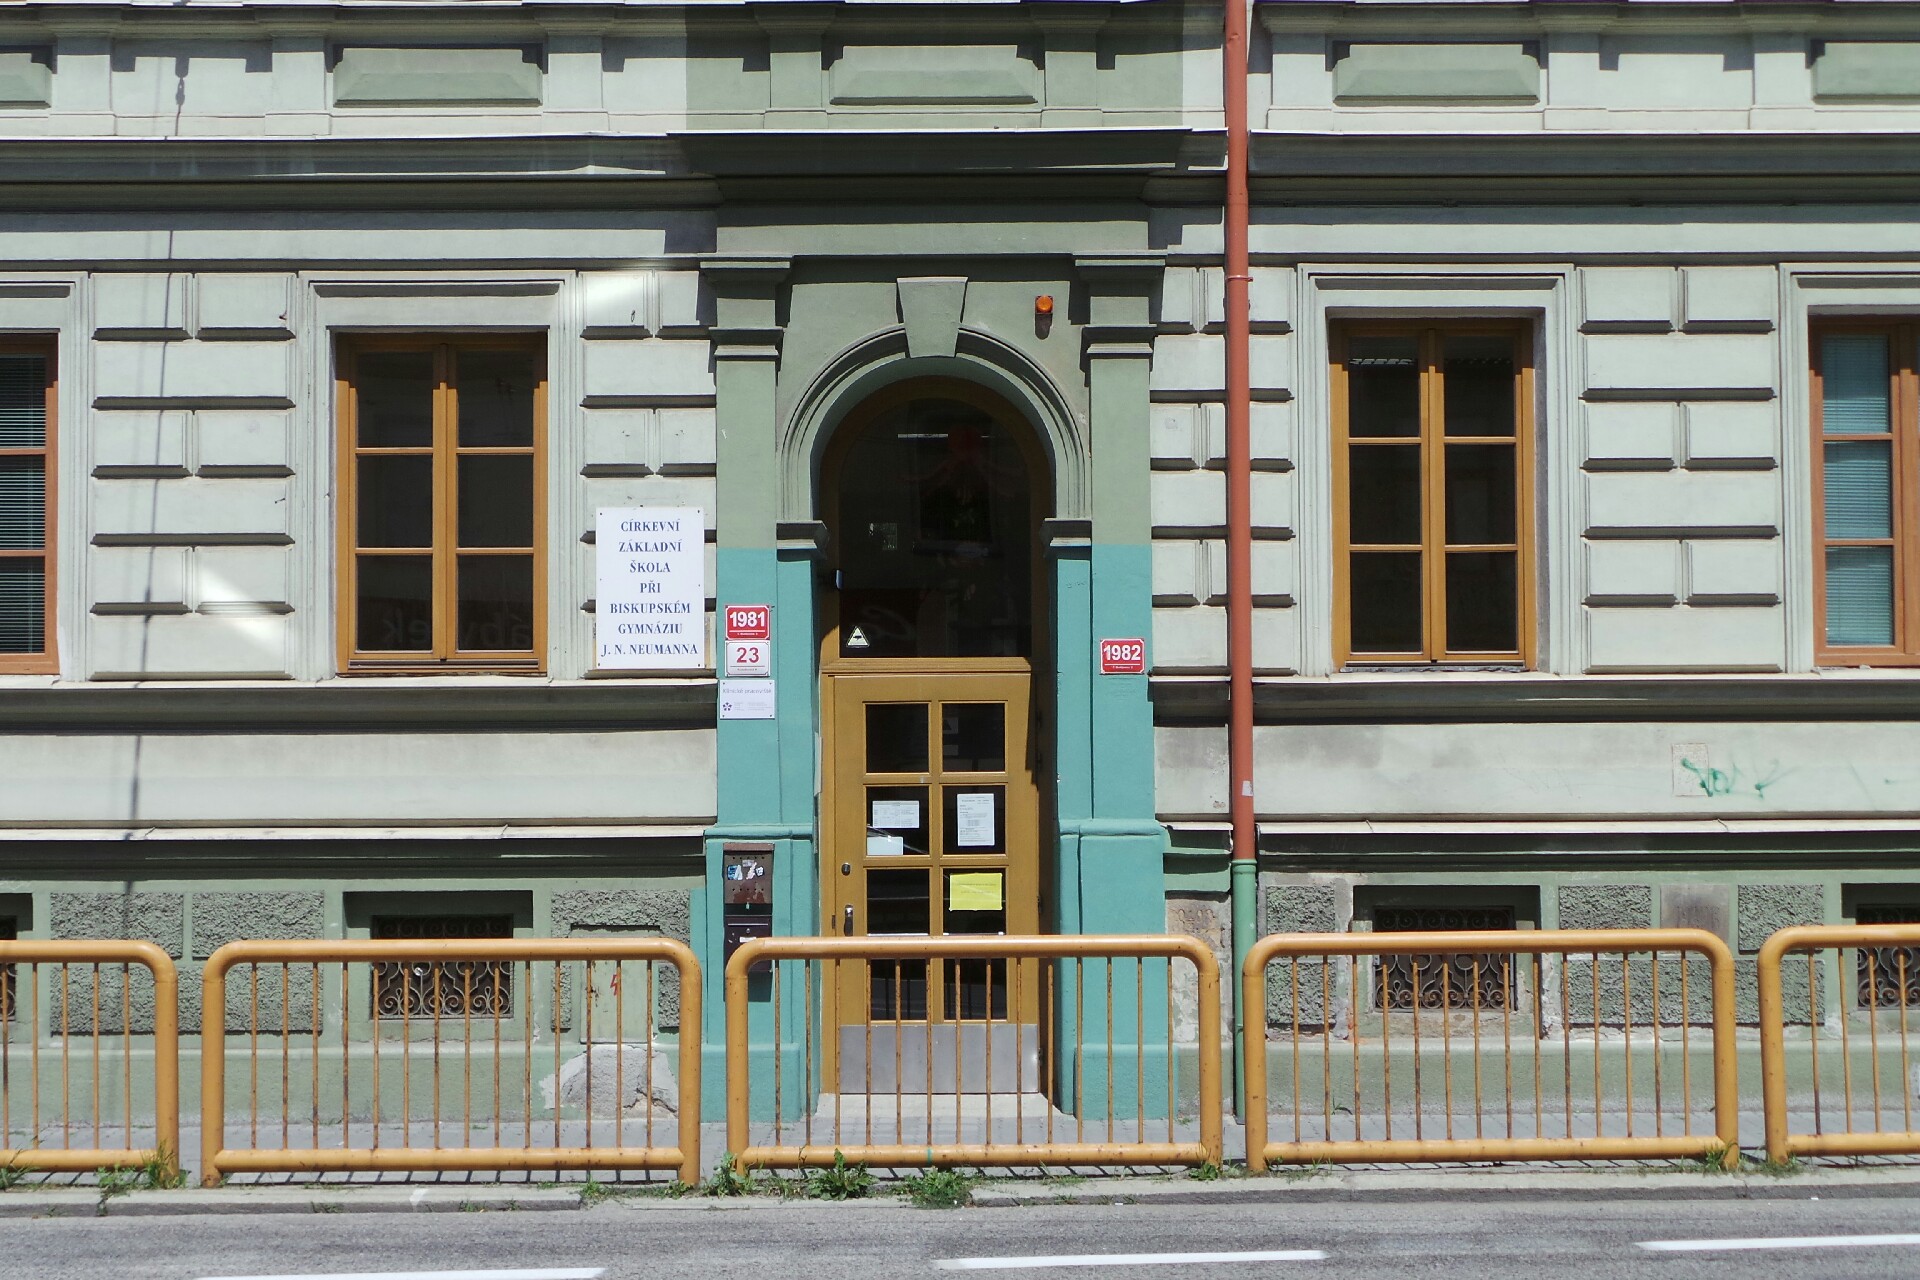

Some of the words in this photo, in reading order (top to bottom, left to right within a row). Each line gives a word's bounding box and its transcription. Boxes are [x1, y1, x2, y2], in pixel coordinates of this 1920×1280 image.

[620, 518, 681, 532] CÍRKEVNÍ
[618, 538, 683, 553] ZÁKLADNÍ
[629, 559, 671, 573] ŠKOLA
[639, 580, 661, 593] PŘI
[609, 600, 691, 614] BISKUPSKÉM
[729, 611, 766, 628] 1981
[617, 621, 683, 635] GYMNÁZIU
[600, 644, 611, 657] J.
[614, 644, 626, 655] N.
[629, 644, 698, 655] NEUMANNA
[736, 648, 760, 664] 23
[1103, 644, 1142, 661] 1982
